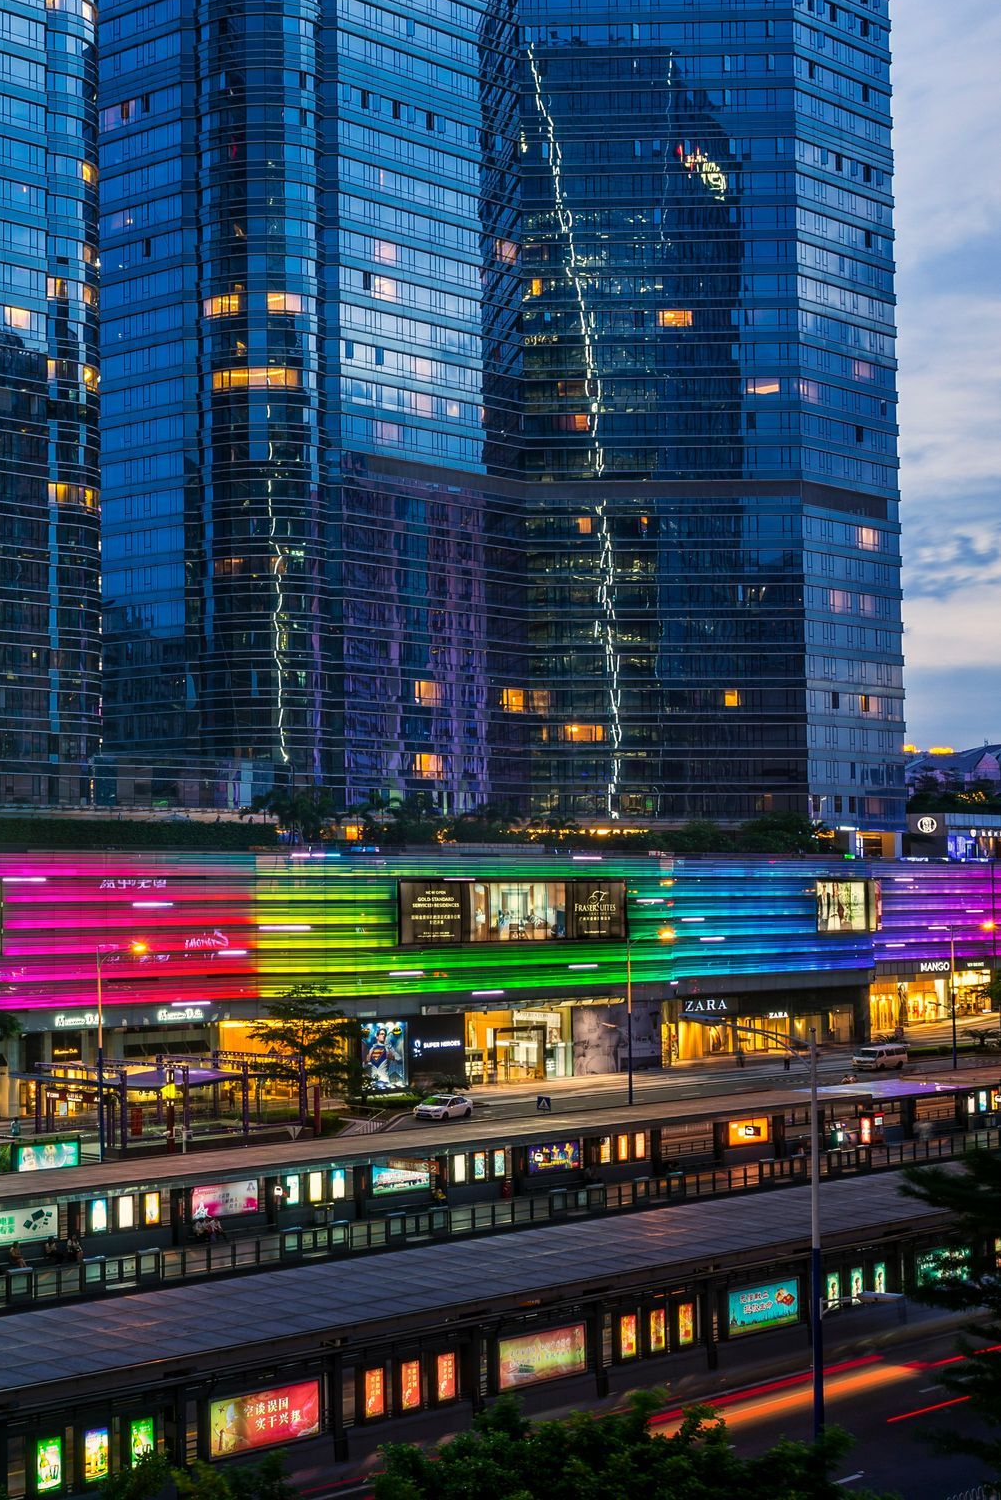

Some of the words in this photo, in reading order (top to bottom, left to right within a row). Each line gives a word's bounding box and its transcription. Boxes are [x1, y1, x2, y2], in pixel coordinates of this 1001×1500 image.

[920, 961, 950, 972] MANGO
[685, 999, 728, 1012] ZARA
[243, 1397, 290, 1418] 空谈误国
[255, 1409, 302, 1431] 实干兴邦
